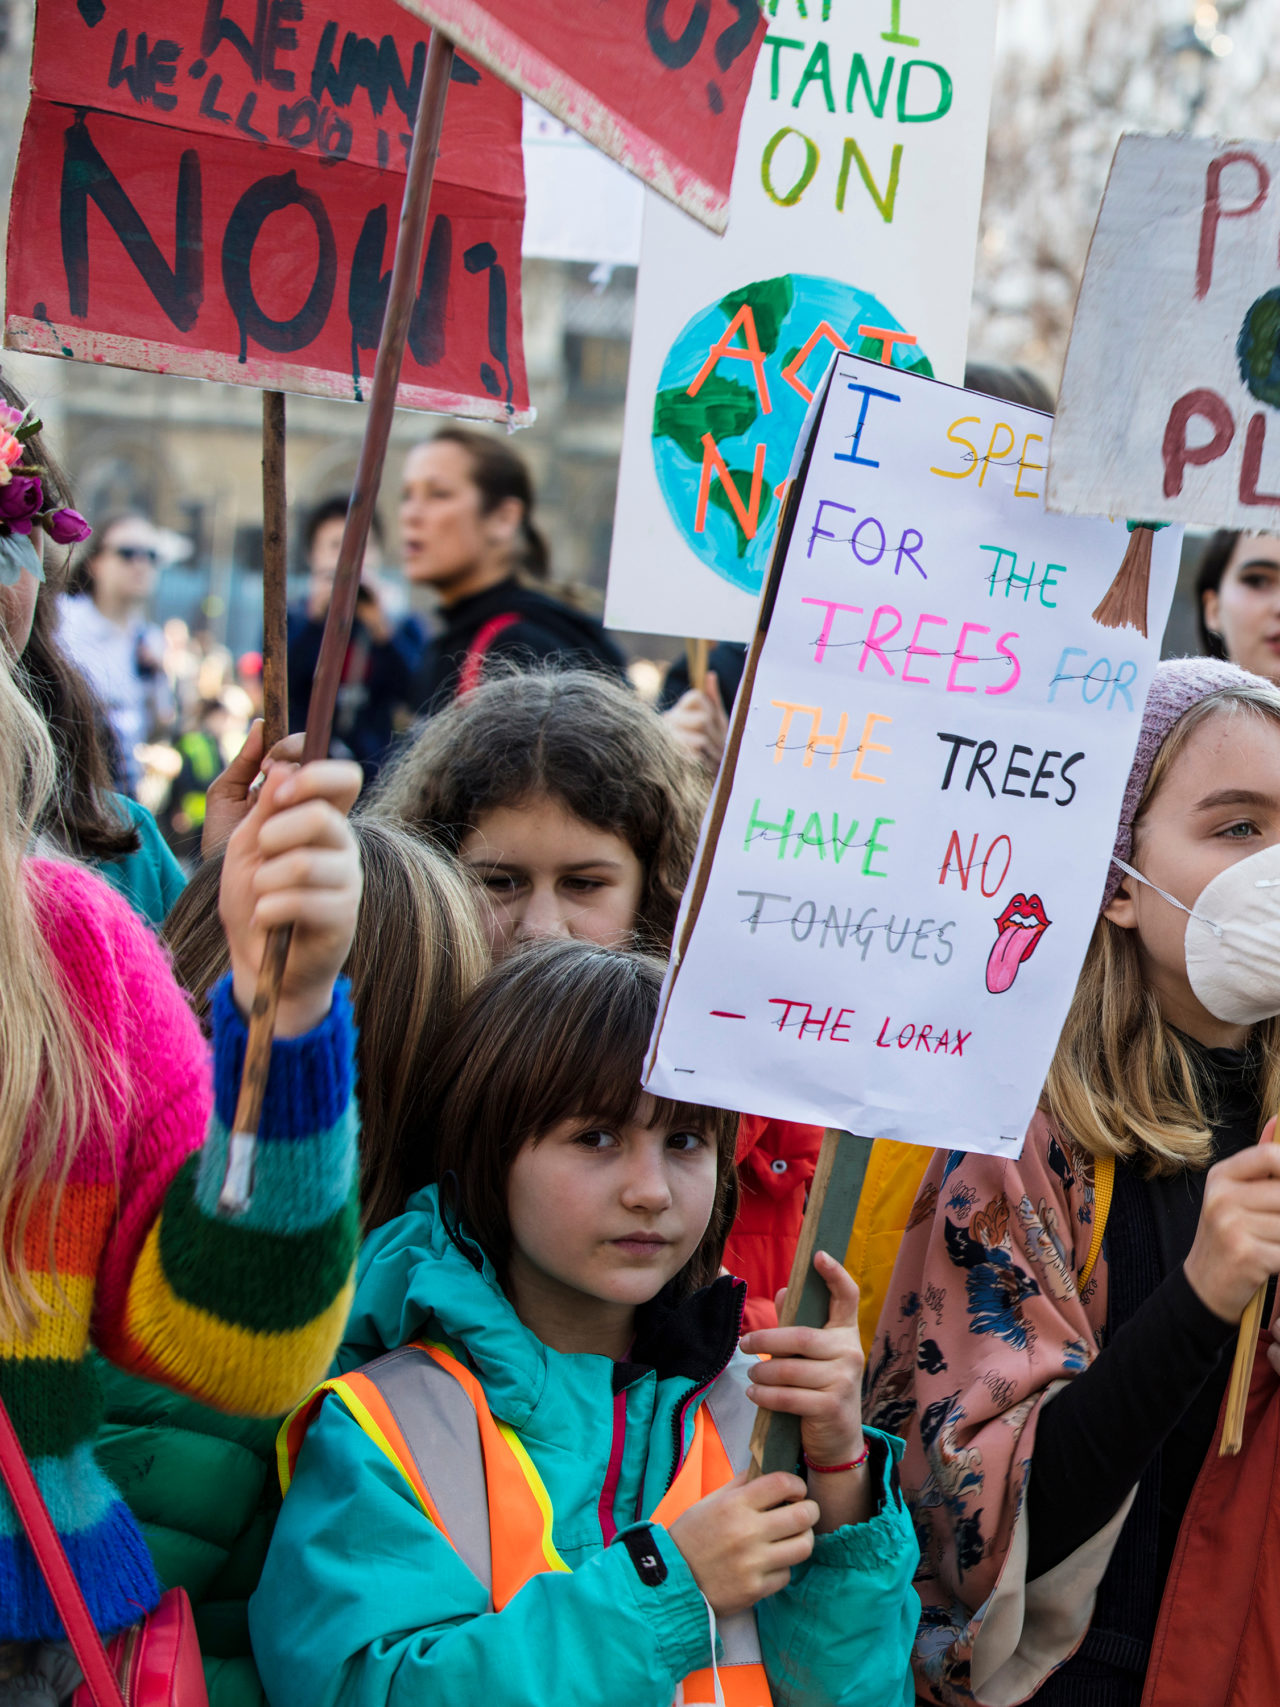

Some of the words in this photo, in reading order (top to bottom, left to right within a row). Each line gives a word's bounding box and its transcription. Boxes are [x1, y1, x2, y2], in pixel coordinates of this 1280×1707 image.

[764, 35, 953, 123] TAND
[761, 126, 903, 223] ON
[834, 383, 902, 469] I
[931, 416, 1045, 498] SPE
[807, 499, 928, 580] FOR
[979, 544, 1067, 608] THE
[801, 597, 1022, 695] TREES
[1047, 646, 1139, 713] FOR
[770, 699, 893, 784] THE
[937, 732, 1085, 807] TREES
[742, 798, 896, 878] HAVE
[938, 829, 1012, 898] NO
[737, 890, 957, 966] TONGUES
[768, 998, 855, 1042] THE
[876, 1016, 972, 1057] LORAX
